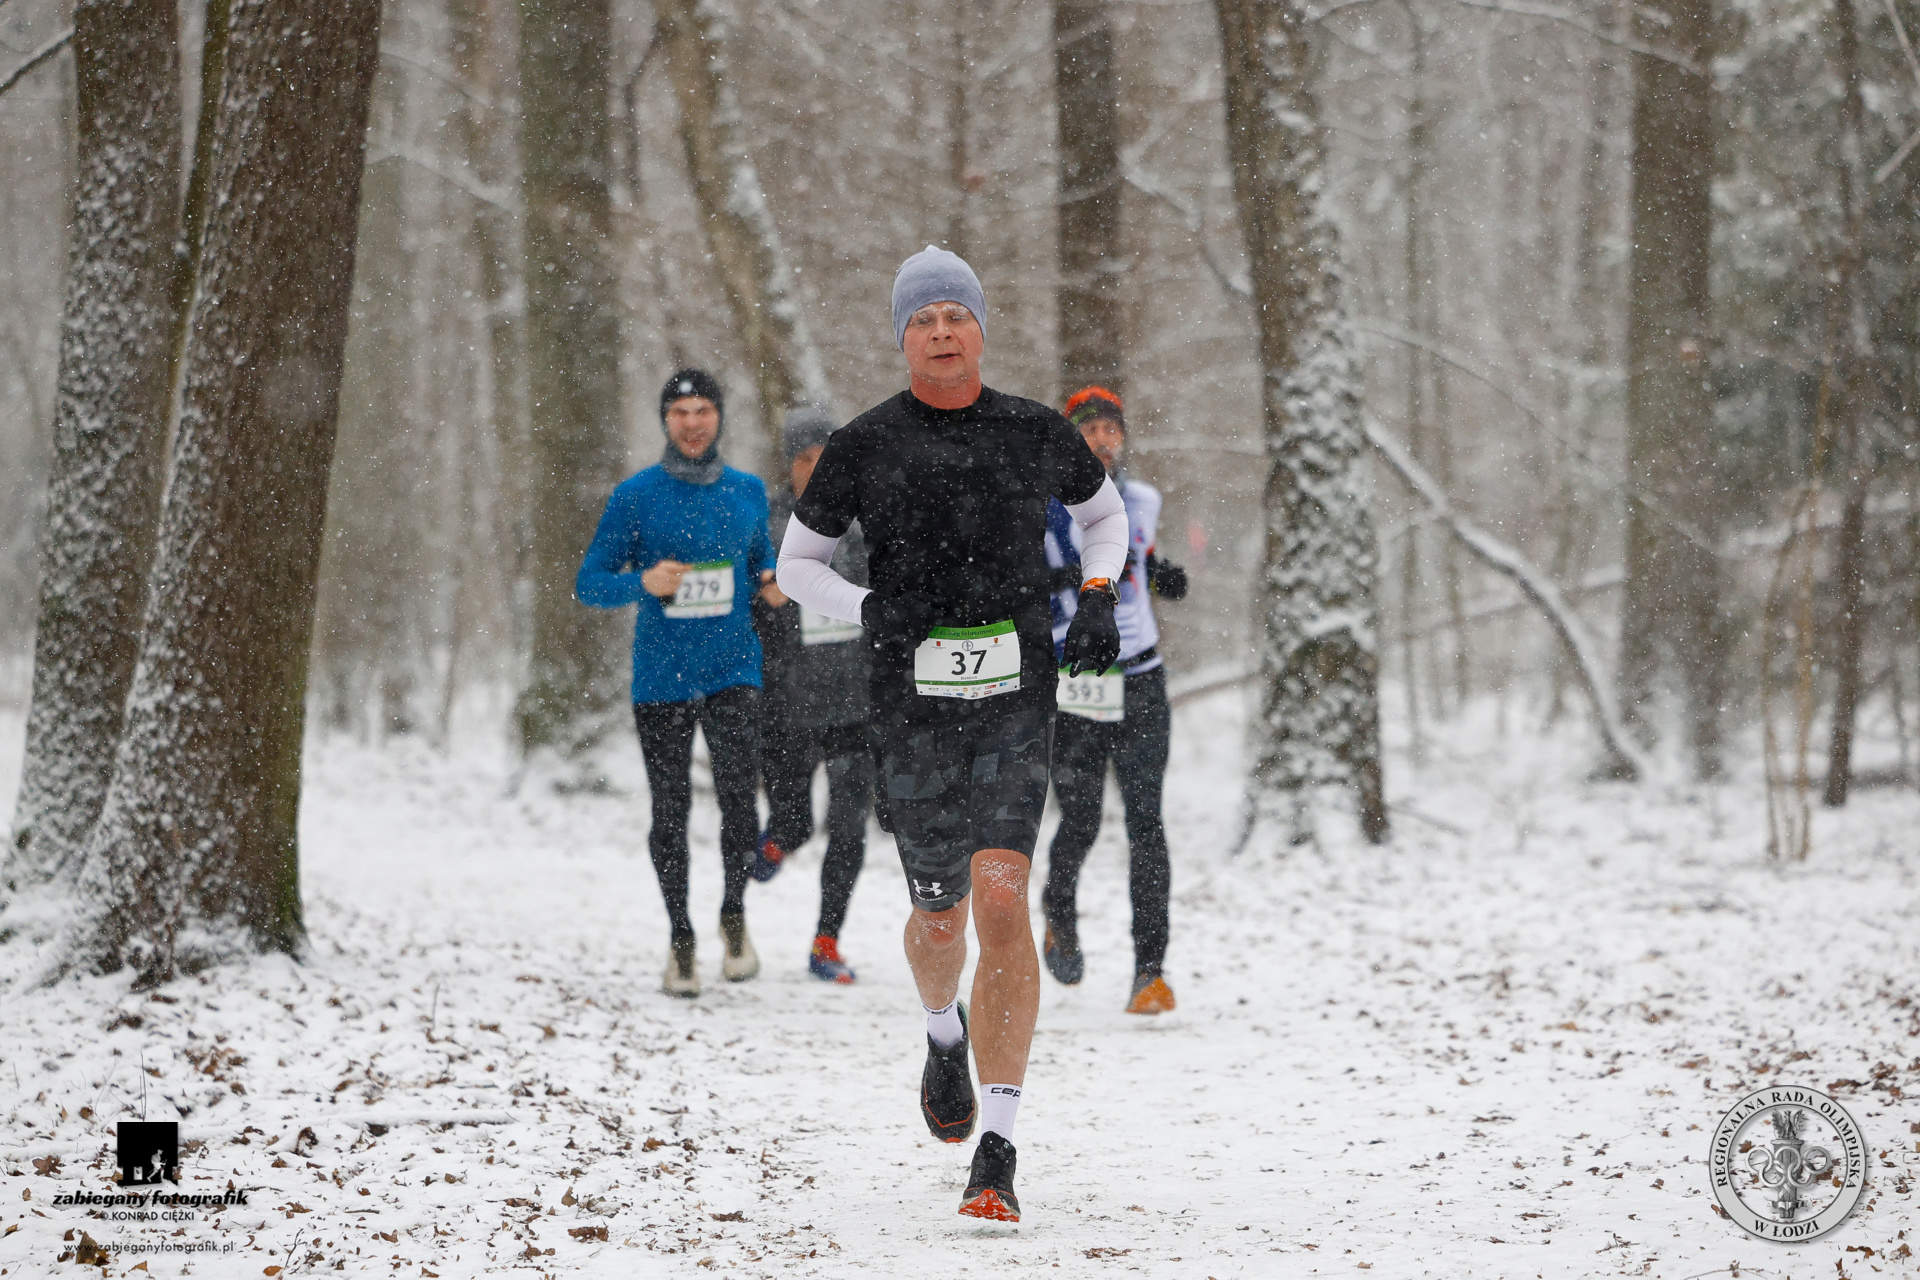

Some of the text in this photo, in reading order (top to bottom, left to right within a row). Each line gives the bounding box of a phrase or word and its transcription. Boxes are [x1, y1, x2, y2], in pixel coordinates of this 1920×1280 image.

[682, 580, 720, 600] 279
[950, 649, 987, 675] 37
[1066, 682, 1105, 703] 593
[991, 1087, 1021, 1097] cep
